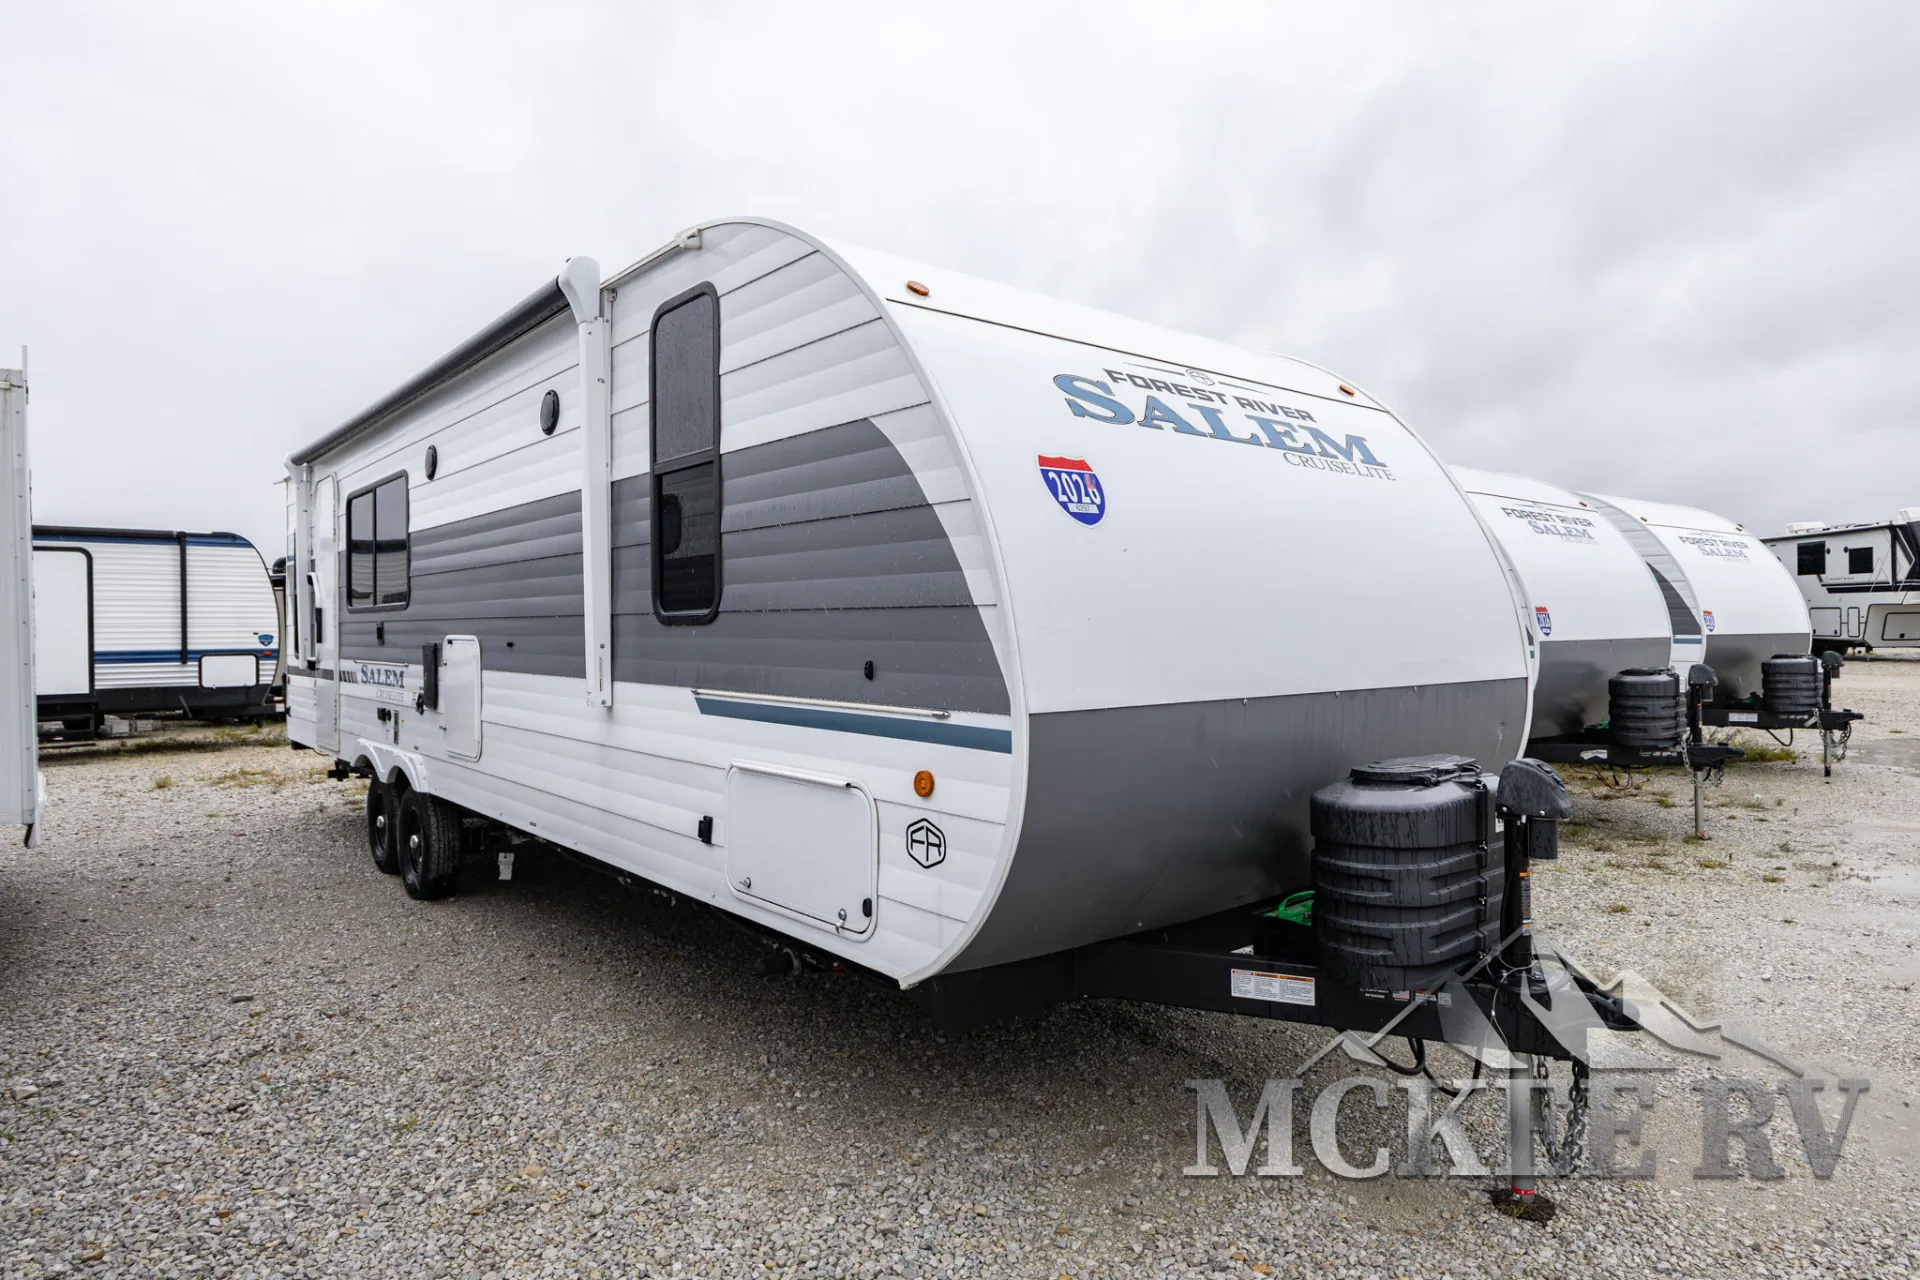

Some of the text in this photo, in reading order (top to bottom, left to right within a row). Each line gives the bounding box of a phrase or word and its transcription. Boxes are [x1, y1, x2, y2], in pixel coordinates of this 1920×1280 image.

[1102, 368, 1318, 423] FOREST RIVER
[1053, 373, 1388, 468] SALEM
[1048, 471, 1102, 505] 2026
[1500, 507, 1595, 528] FOREST RIVER
[1528, 520, 1594, 539] SALEM
[1697, 543, 1749, 558] SALEM
[361, 664, 405, 688] SALEM
